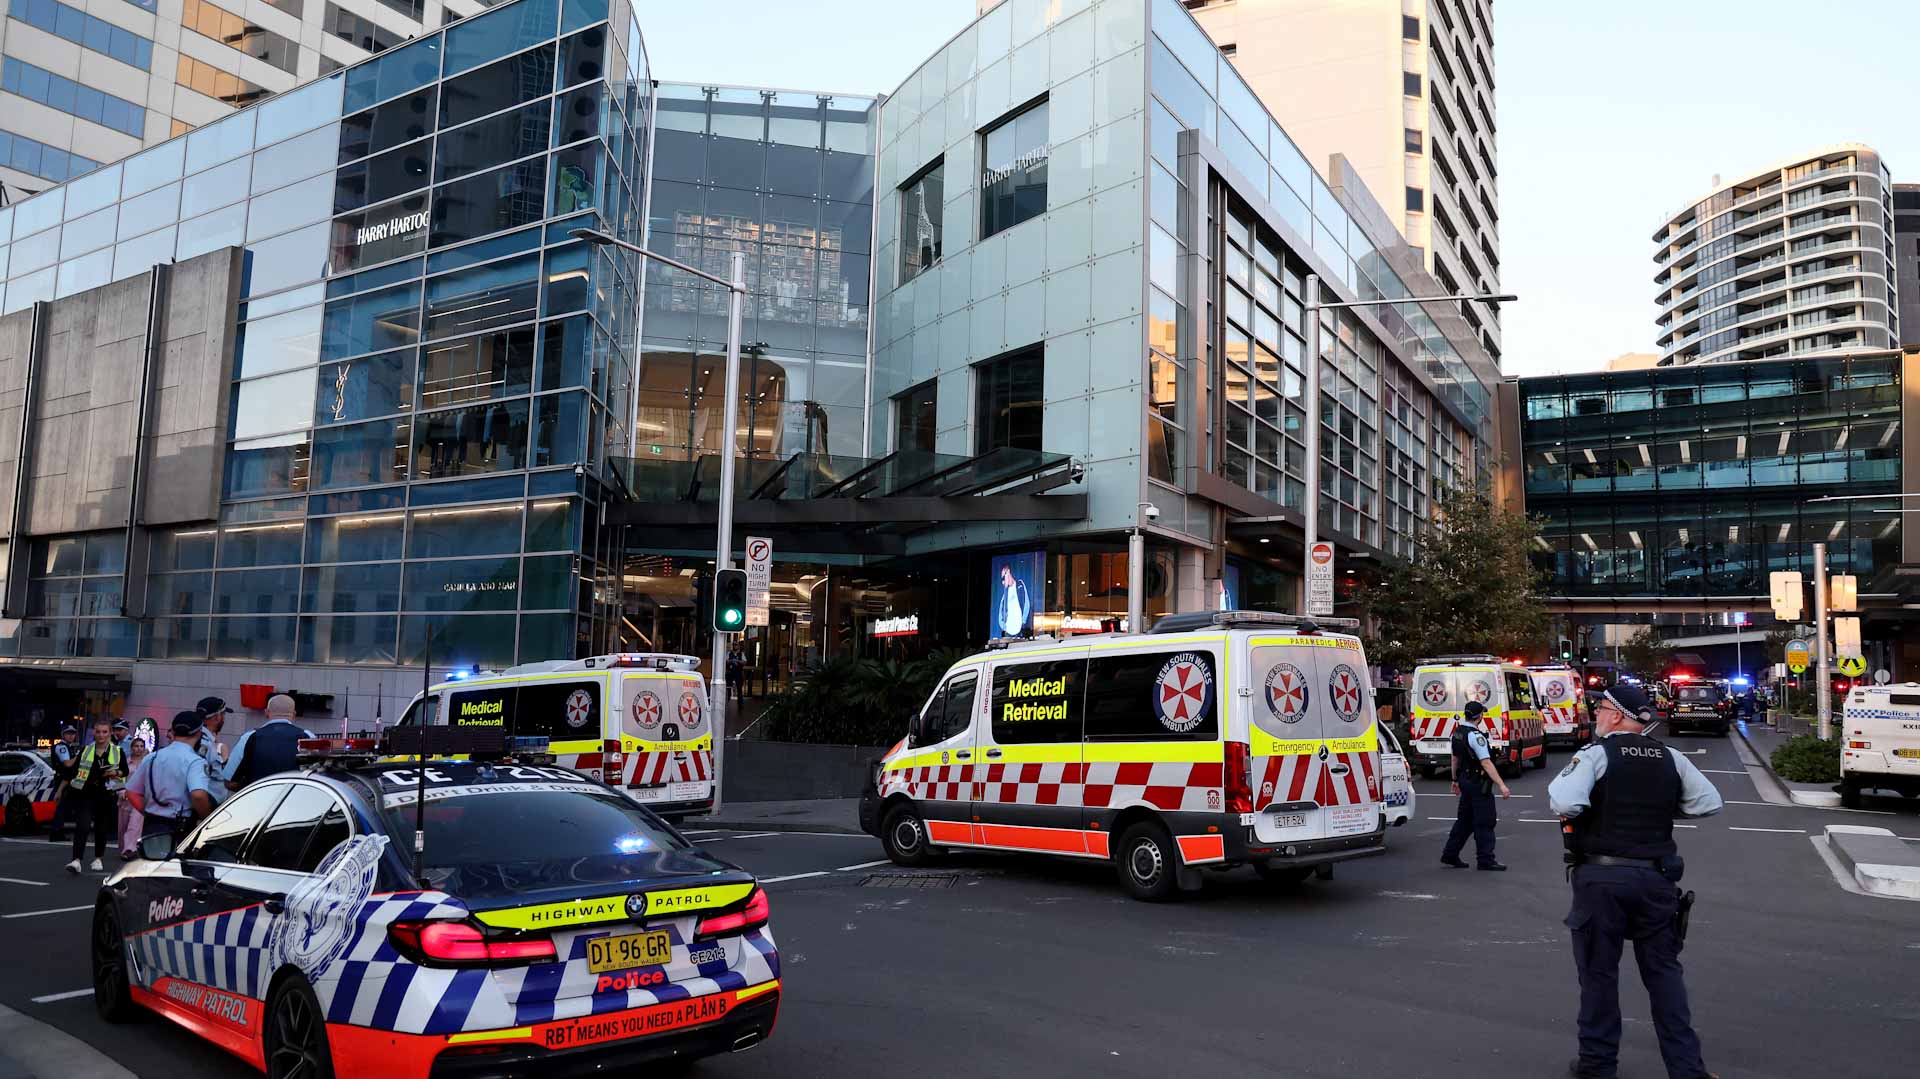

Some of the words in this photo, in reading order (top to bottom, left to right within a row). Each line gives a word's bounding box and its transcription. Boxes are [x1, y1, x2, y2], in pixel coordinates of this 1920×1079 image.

[982, 163, 1010, 189] HARRY
[357, 222, 390, 245] HARRY
[390, 211, 430, 236] HARTOG
[751, 563, 765, 572] NO
[748, 580, 767, 588] TURN
[1156, 663, 1170, 685] NEW
[1170, 653, 1195, 667] SOUTH
[1194, 656, 1212, 685] WALES
[1008, 675, 1066, 698] Medical
[460, 699, 503, 716] Medical
[1003, 700, 1068, 722] Retrieval
[1160, 713, 1203, 732] AMBULANCE
[654, 742, 687, 751] Ambulance
[1272, 741, 1315, 754] Emergency
[1332, 740, 1366, 750] Ambulance
[1620, 746, 1663, 759] POLICE
[382, 767, 453, 786] CE
[493, 765, 586, 782] 213
[397, 788, 461, 804] Don't
[465, 783, 524, 795] Drink
[148, 896, 184, 924] Police
[531, 903, 616, 922] HIGHWAY
[655, 893, 711, 908] PATROL
[613, 960, 639, 969] SOUTH
[641, 957, 660, 965] WALES
[690, 947, 726, 965] CE213
[597, 970, 665, 993] Police
[167, 981, 203, 1010] HIGHWAY
[202, 990, 248, 1026] PATROL
[546, 1025, 575, 1047] RBT
[577, 1022, 619, 1042] MEANS
[621, 1018, 643, 1033] YOU
[647, 1013, 674, 1028] NEED
[675, 1012, 683, 1022] A
[685, 1001, 717, 1021] PLAN
[719, 998, 727, 1014] B
